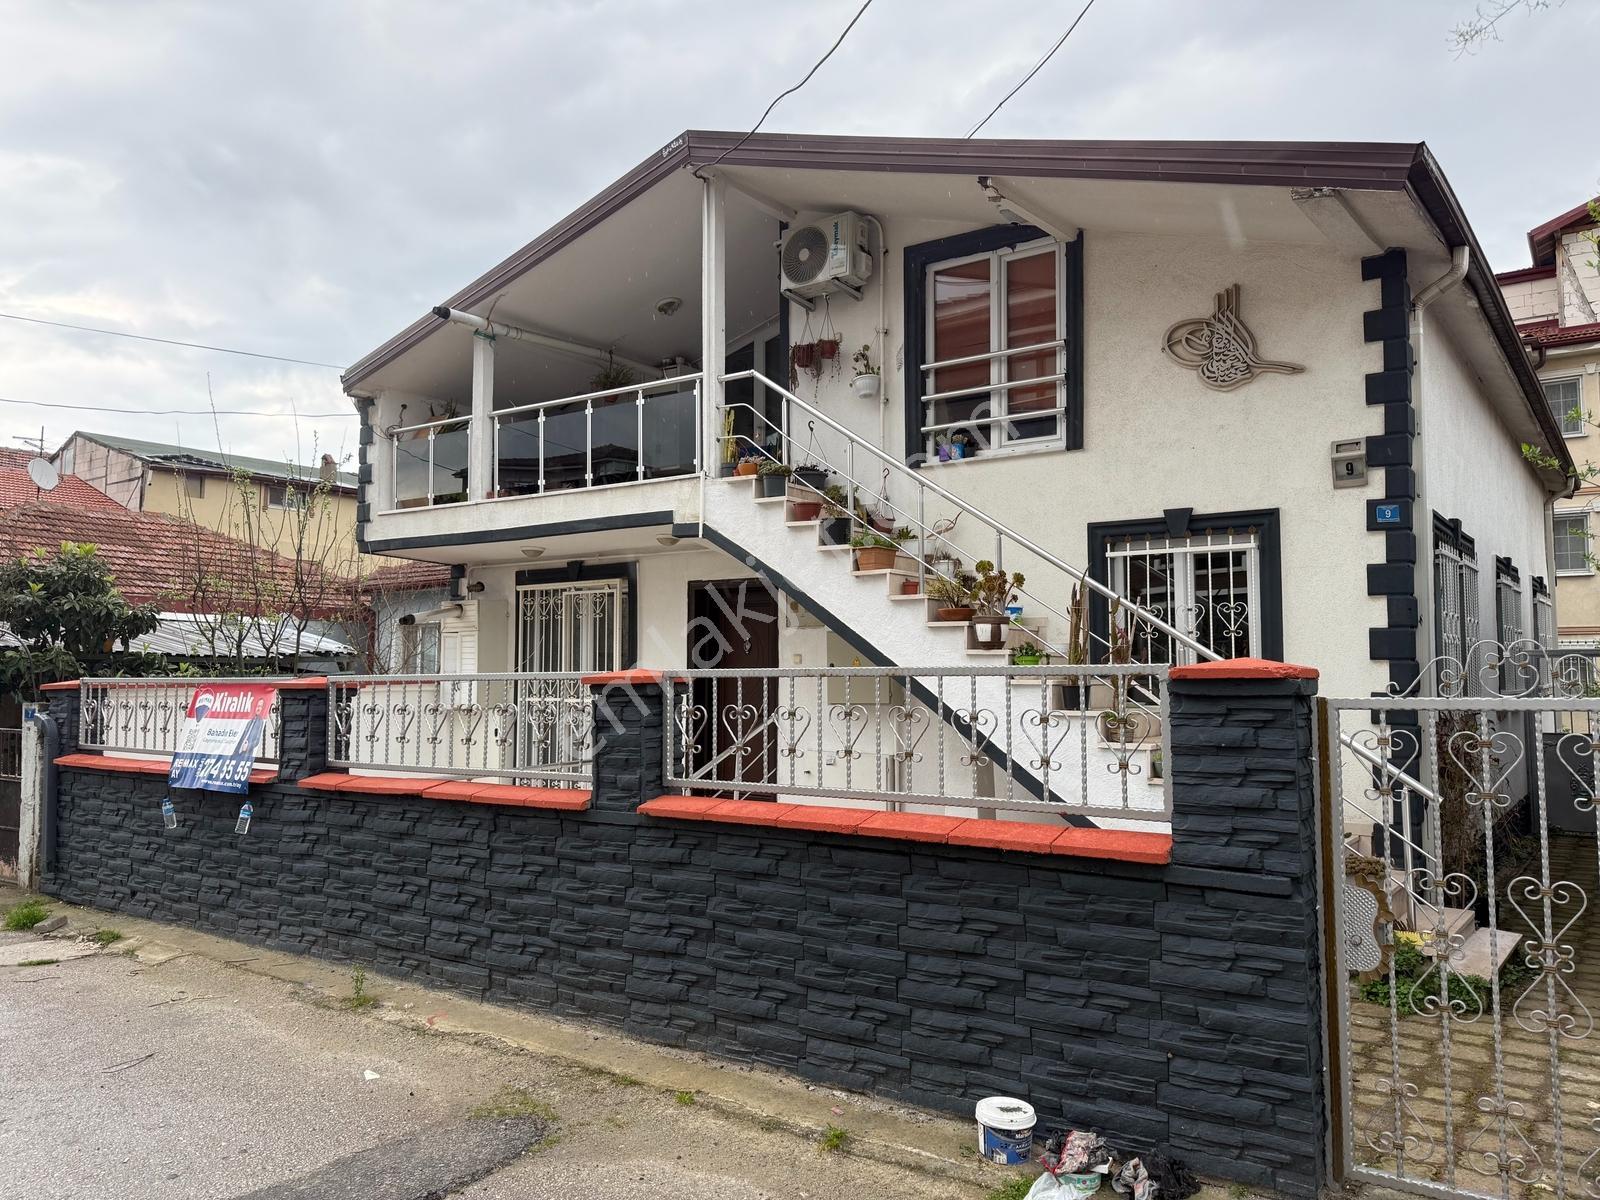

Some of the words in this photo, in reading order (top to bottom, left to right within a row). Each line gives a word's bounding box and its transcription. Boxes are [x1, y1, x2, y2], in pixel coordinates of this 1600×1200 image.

[1345, 462, 1354, 476] 9
[1385, 509, 1391, 518] 9
[212, 691, 254, 713] Kiralık
[235, 761, 251, 781] 55
